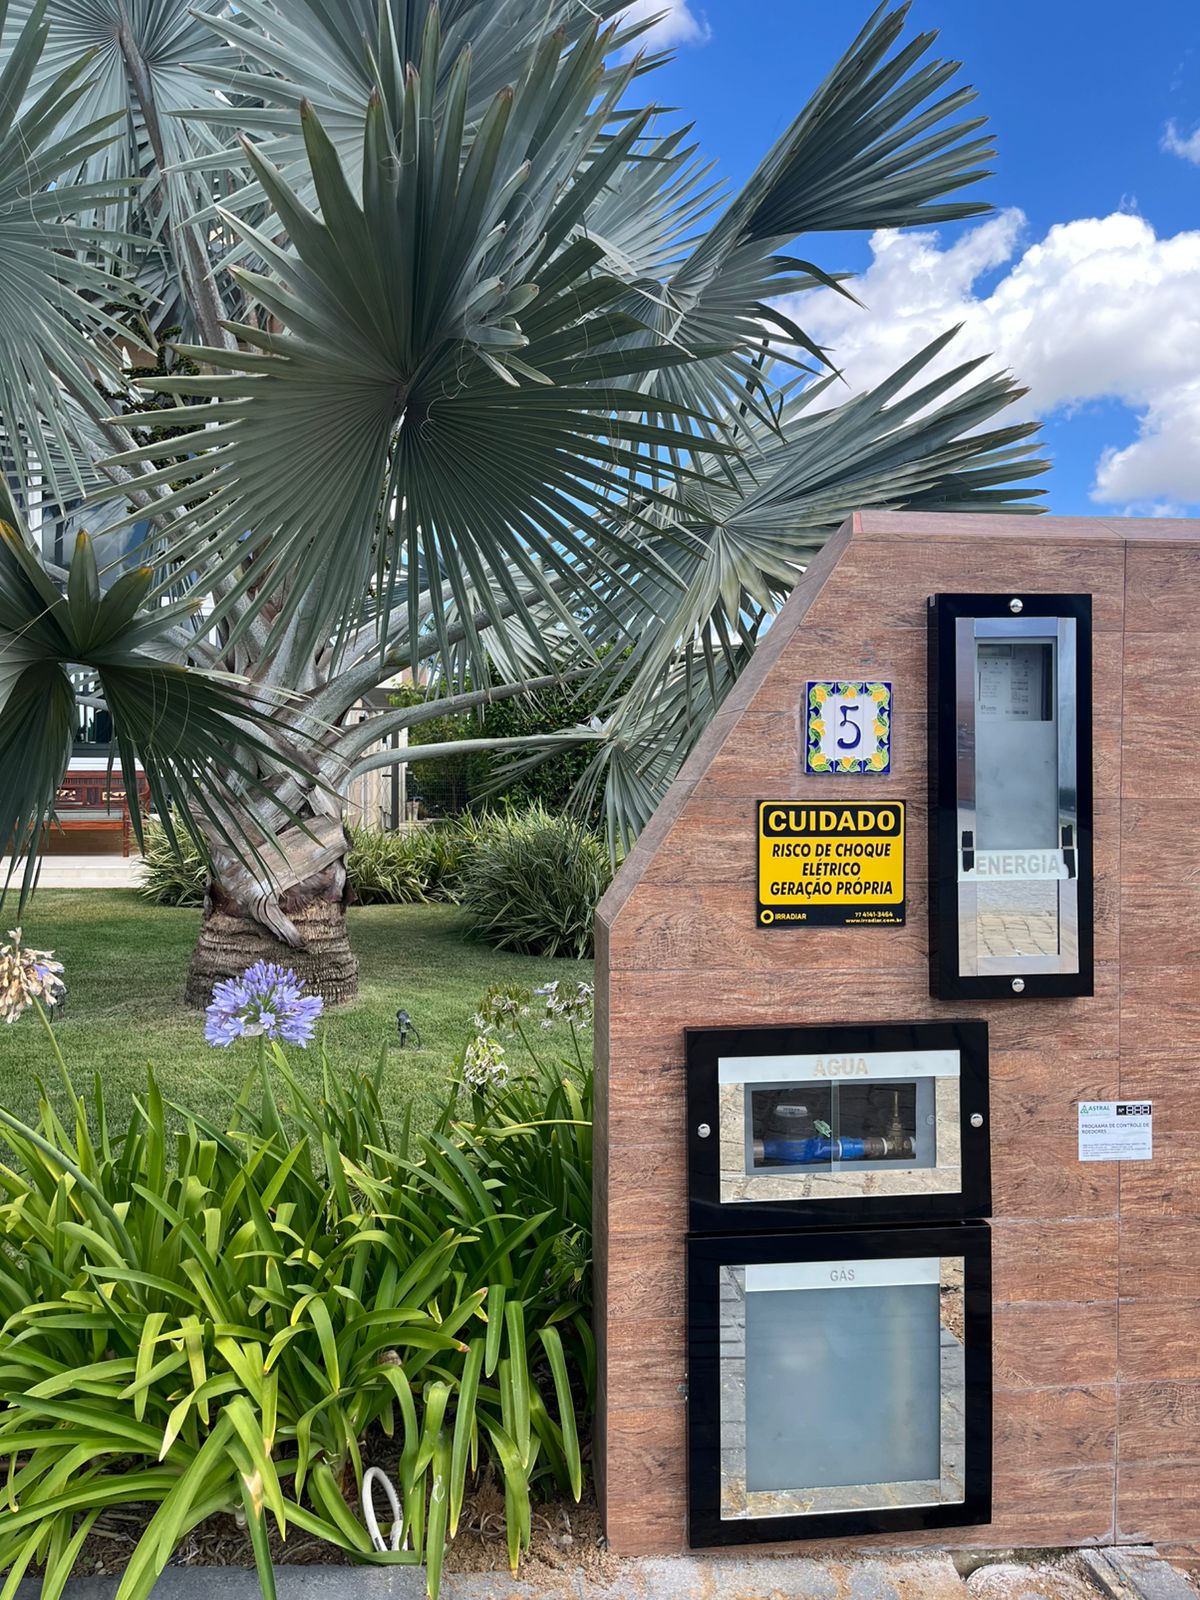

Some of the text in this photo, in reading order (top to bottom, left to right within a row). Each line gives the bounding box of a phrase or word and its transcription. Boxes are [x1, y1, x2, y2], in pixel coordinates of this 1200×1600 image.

[837, 705, 862, 749] 5
[768, 810, 895, 831] CUIDADO
[772, 843, 891, 858] RISCO DE CHOQUE
[802, 858, 861, 876] ELÉTRICO
[976, 855, 1060, 875] ENERGIA
[770, 877, 893, 899] GERAÇÃO PRÓPRIA
[830, 1266, 855, 1281] GÁS
